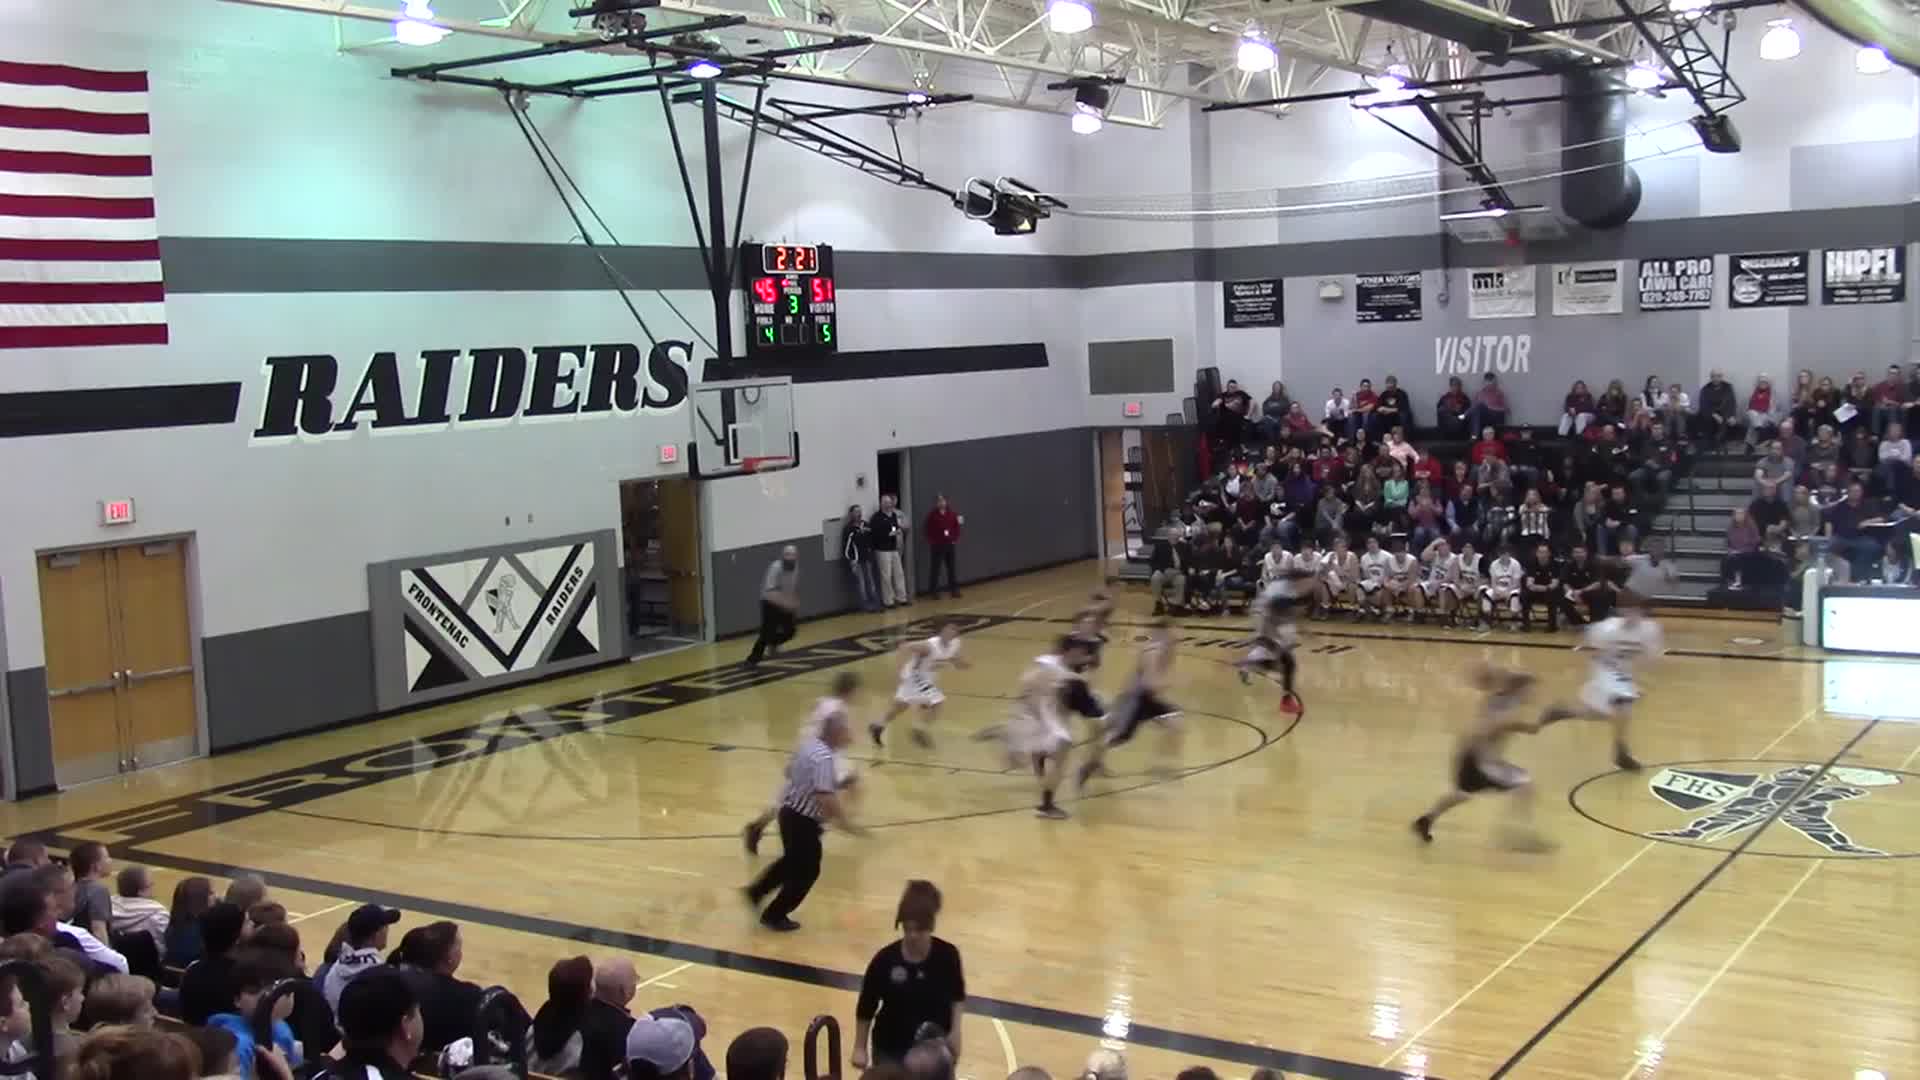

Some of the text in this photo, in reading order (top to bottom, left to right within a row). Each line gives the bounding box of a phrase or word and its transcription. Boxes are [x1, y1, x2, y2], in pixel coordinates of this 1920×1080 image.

[776, 246, 815, 270] 2:21
[1642, 259, 1711, 277] ALL PRO
[754, 278, 777, 302] 45
[812, 278, 833, 302] 51
[1640, 276, 1677, 291] LAWN
[789, 295, 799, 314] 3
[765, 327, 775, 343] 4
[822, 324, 832, 342] 5
[1435, 335, 1530, 374] VISITOR
[250, 340, 695, 445] RAIDERS
[110, 502, 129, 520] EXIT
[545, 564, 584, 626] RAIDERS
[408, 582, 469, 649] FRONTENAC
[1665, 773, 1734, 798] FHS
